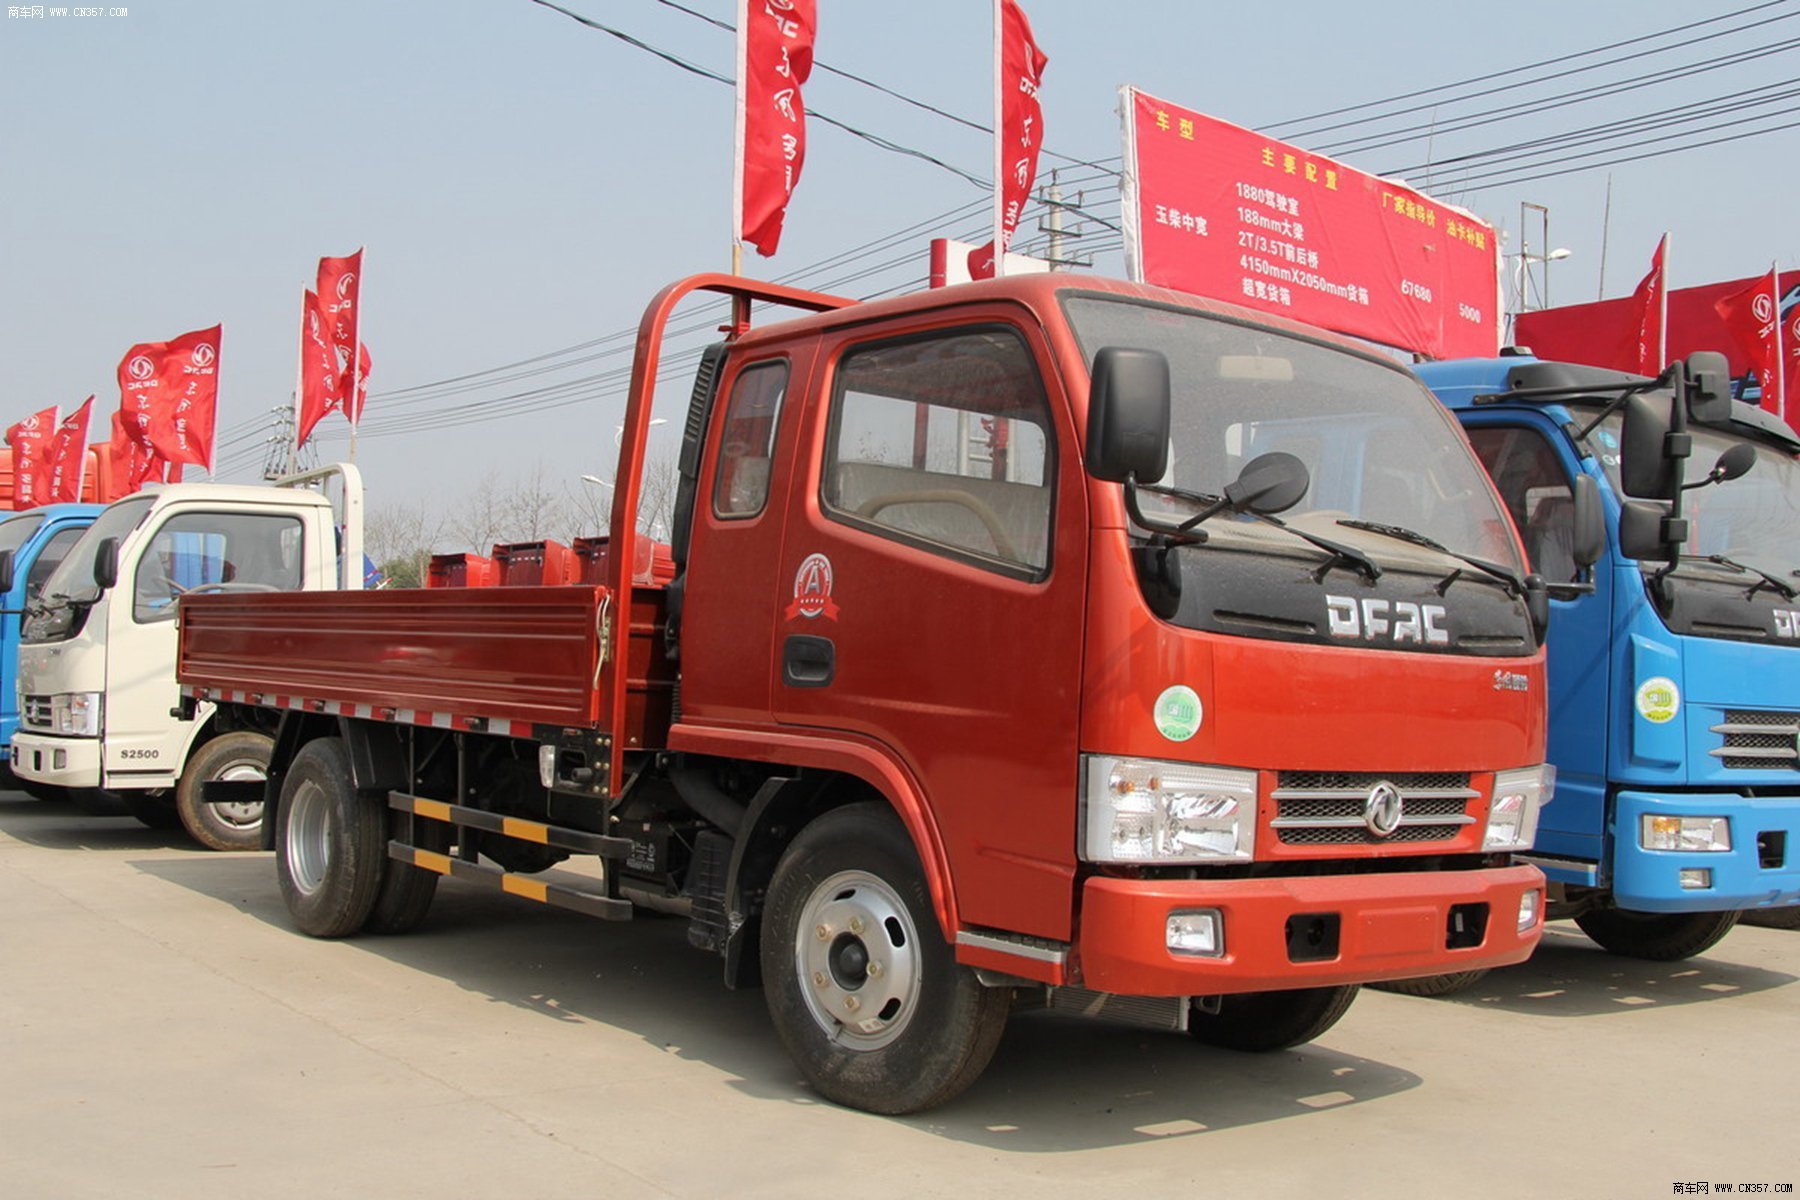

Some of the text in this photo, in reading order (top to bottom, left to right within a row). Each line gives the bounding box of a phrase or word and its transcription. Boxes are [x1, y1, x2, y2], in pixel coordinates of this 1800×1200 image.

[1156, 110, 1195, 141] 车型
[1262, 147, 1338, 191] 主要配置
[1236, 182, 1299, 216] 1880驾驶室
[1383, 191, 1436, 229] 厂家指导价
[1155, 204, 1208, 236] 玉柴中宽
[1237, 207, 1304, 241] 188mm大梁
[1238, 231, 1319, 269] 2T/3.5T前后桥
[1240, 254, 1369, 305] 4150mmX2050mm货箱
[1242, 277, 1291, 306] 超宽货箱
[1401, 279, 1432, 303] 67680
[1459, 303, 1481, 324] 5000
[1325, 594, 1449, 643] DFAC
[121, 750, 159, 759] S2500
